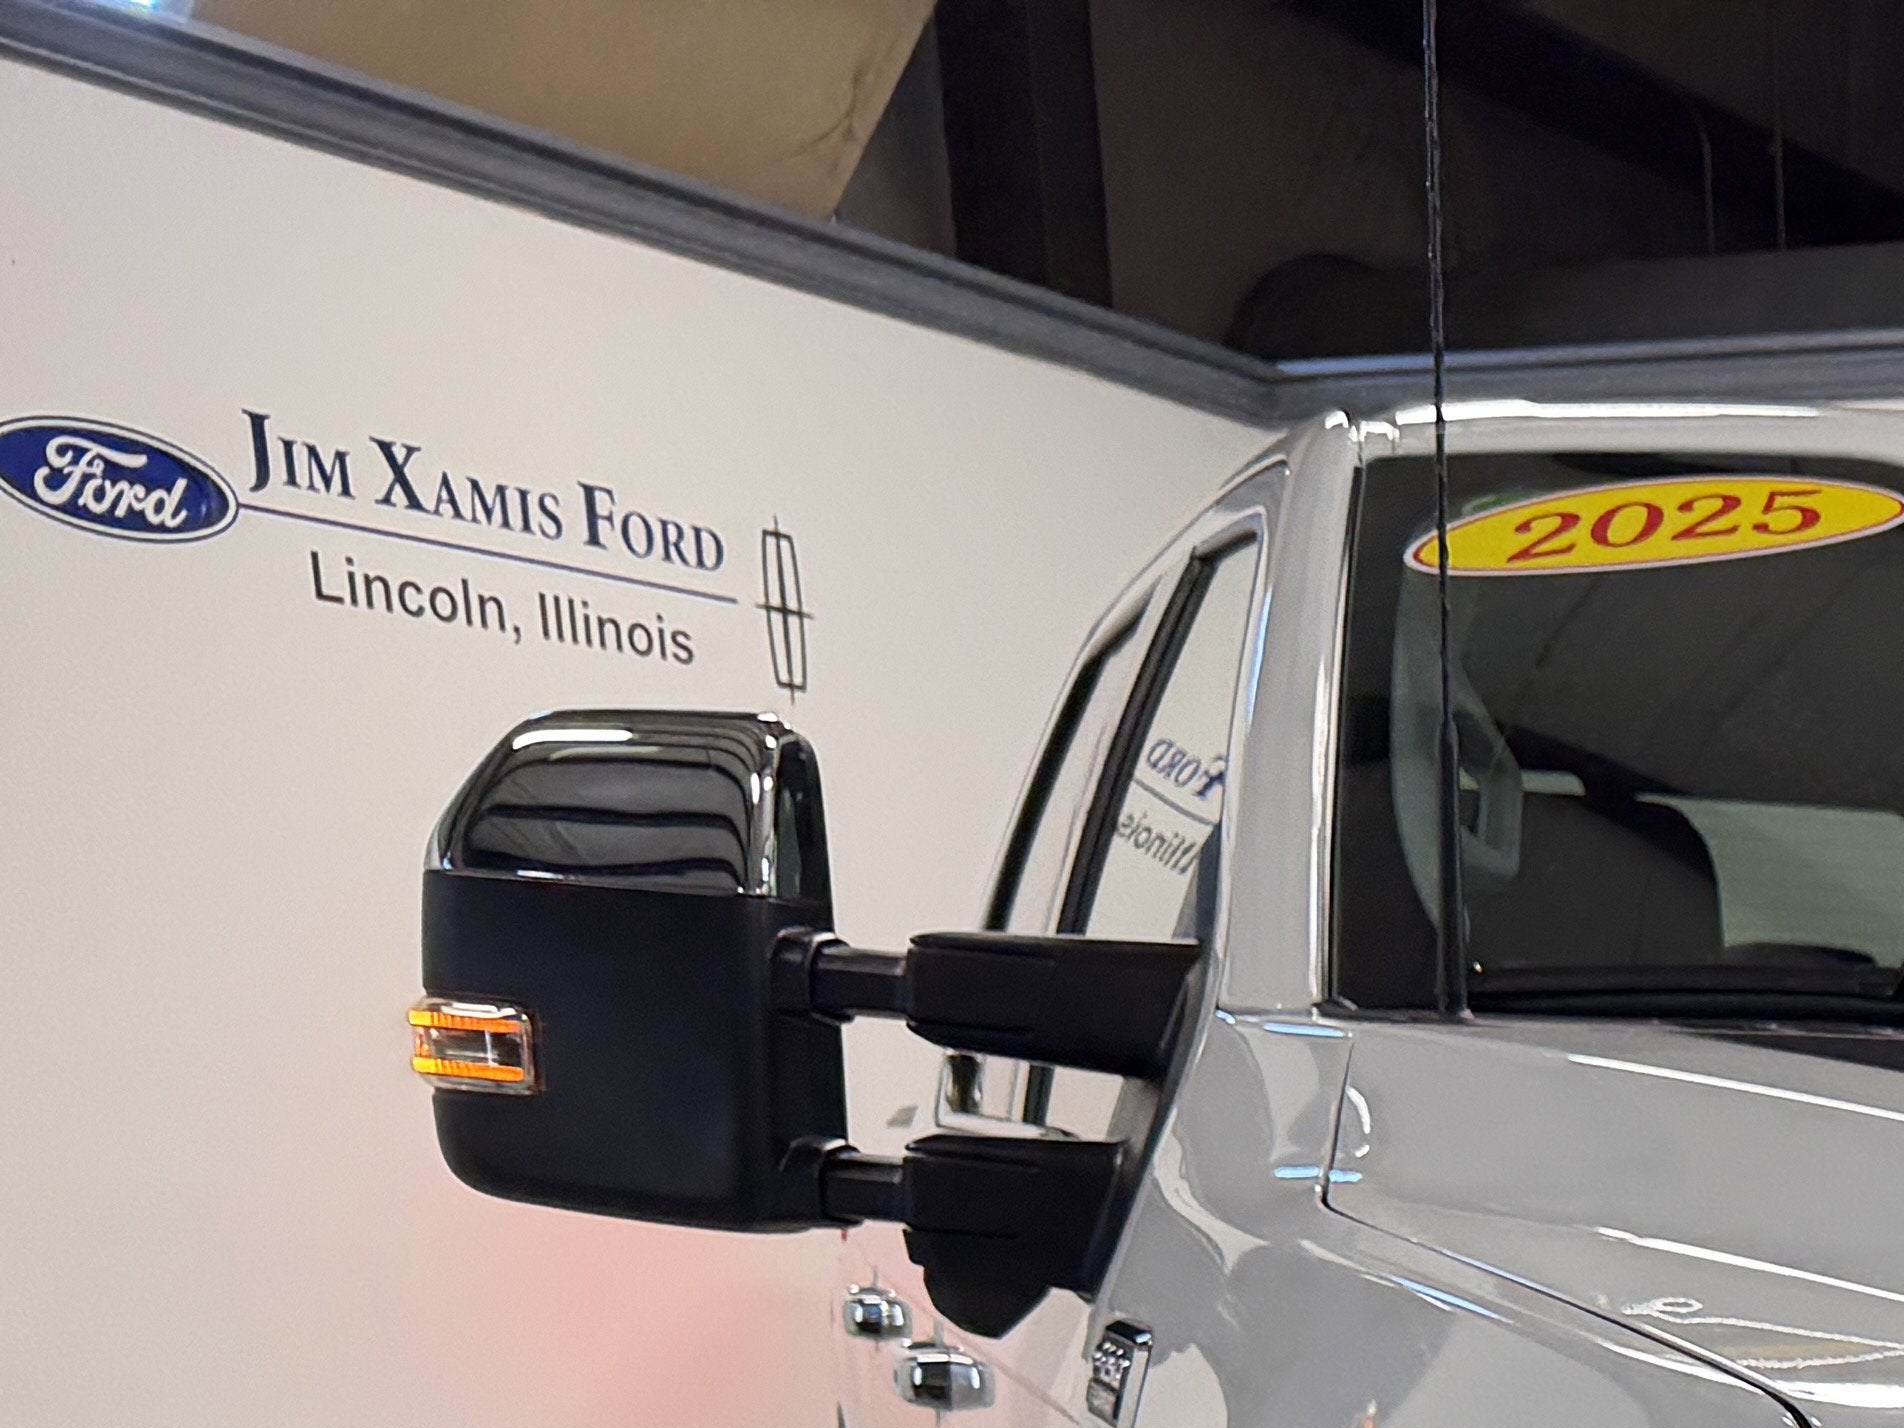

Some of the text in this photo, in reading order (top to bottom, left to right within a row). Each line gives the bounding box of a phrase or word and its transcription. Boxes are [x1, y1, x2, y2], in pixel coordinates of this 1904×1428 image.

[34, 436, 187, 530] Ford
[242, 410, 725, 573] JIM XAMIS FORD
[1506, 489, 1823, 563] 2025
[309, 550, 696, 666] Lincoln, Illinois
